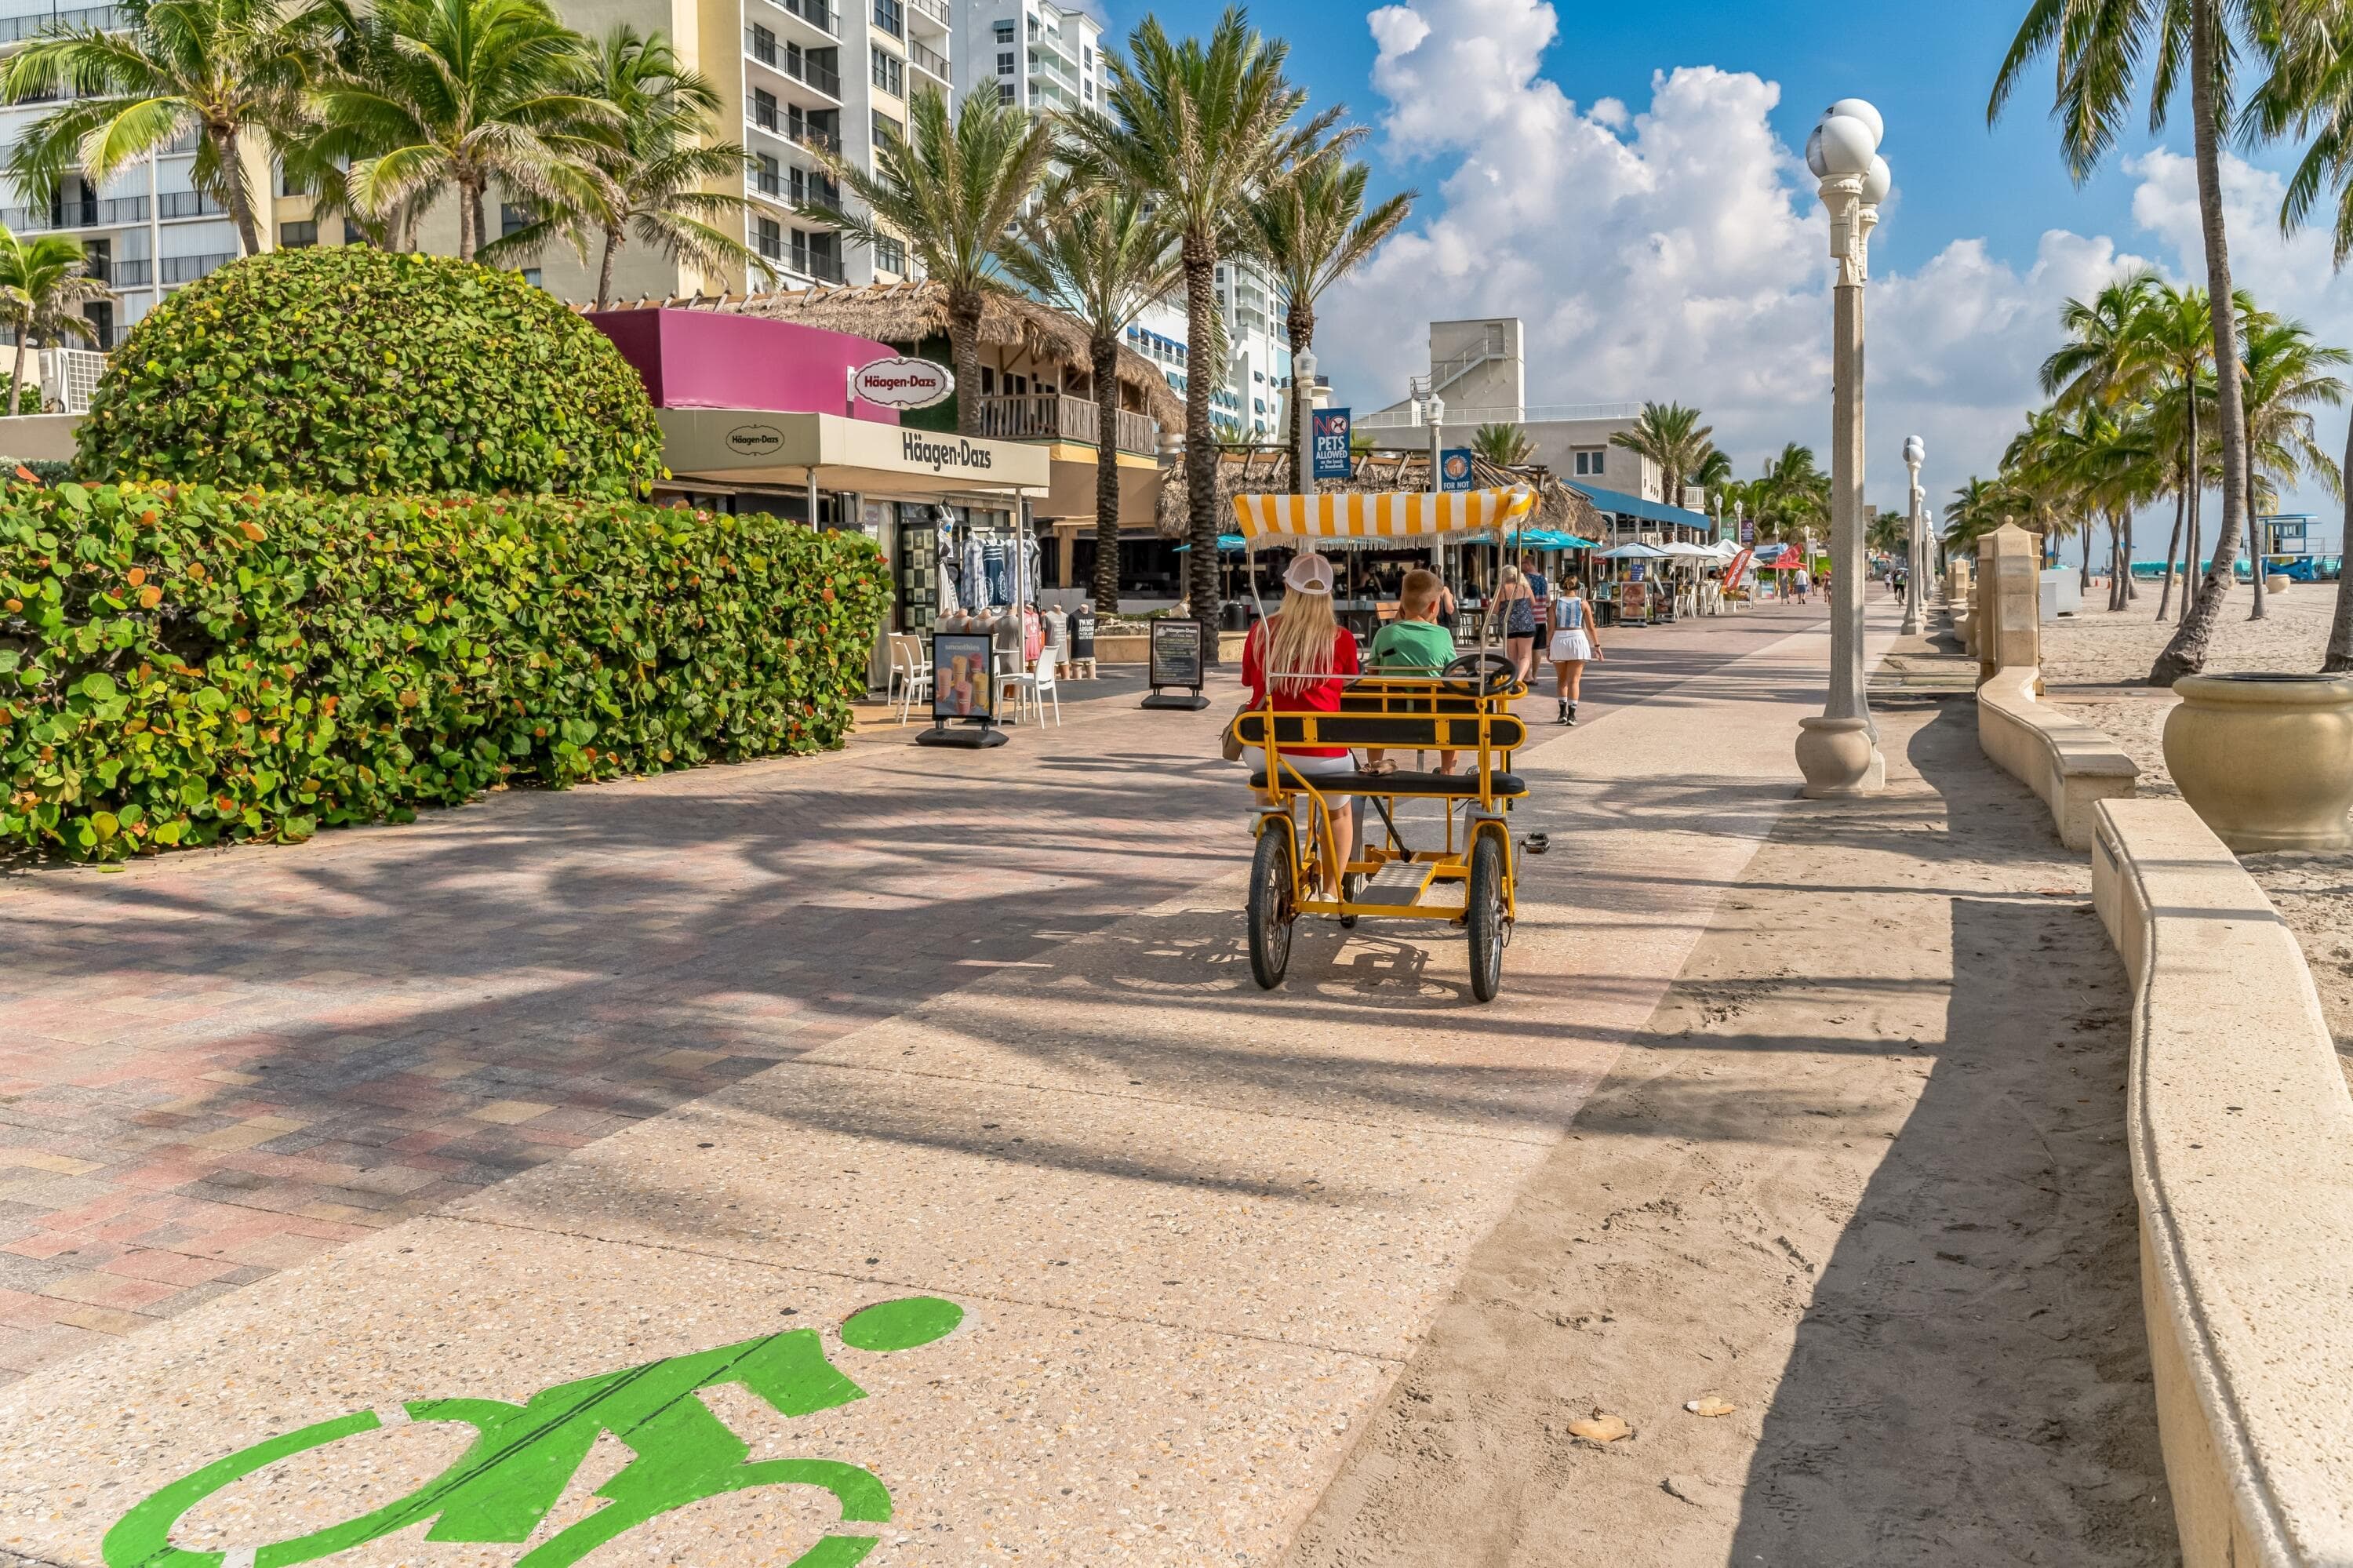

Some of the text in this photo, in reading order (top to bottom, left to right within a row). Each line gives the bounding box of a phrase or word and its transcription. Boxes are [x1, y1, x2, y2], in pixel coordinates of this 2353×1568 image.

[864, 375, 936, 391] Häagen-Dazs
[732, 435, 779, 446] Häagen-Dazs
[1318, 435, 1345, 451] PETS
[902, 431, 991, 471] Häagen-Dazs
[1315, 449, 1347, 460] ALLOWED
